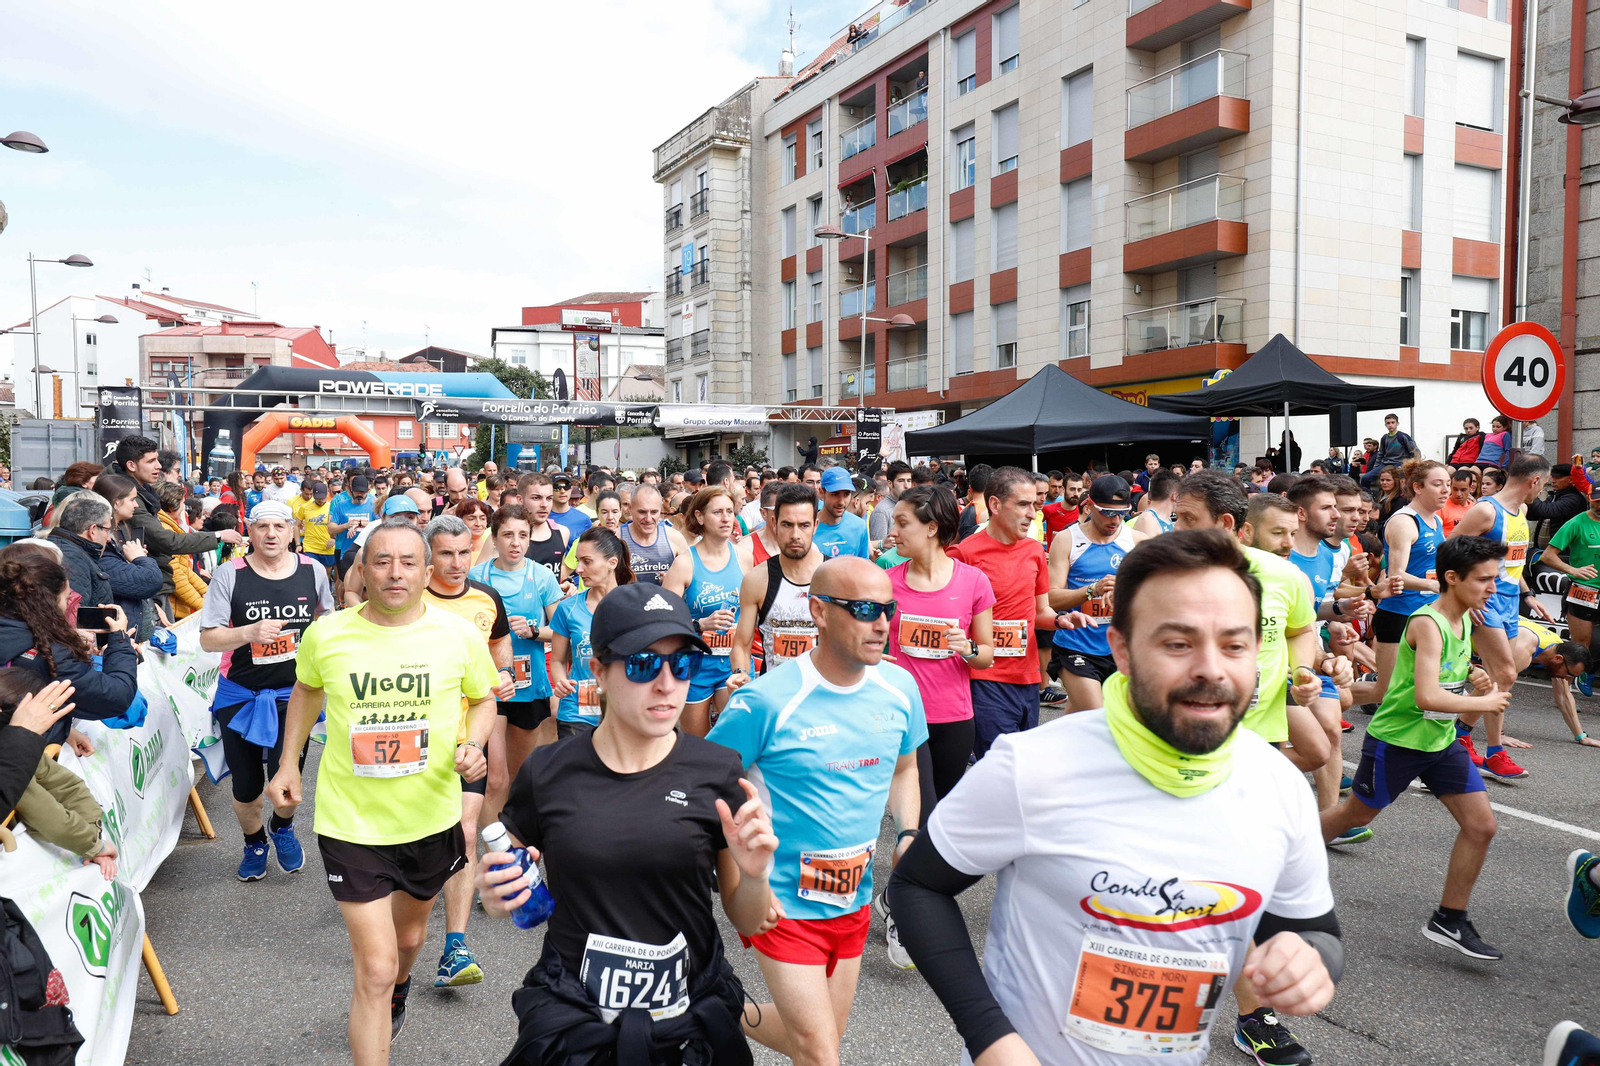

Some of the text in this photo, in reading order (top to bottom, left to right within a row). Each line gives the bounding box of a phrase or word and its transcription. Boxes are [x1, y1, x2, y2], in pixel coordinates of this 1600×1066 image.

[684, 251, 692, 268] 19
[1503, 357, 1550, 388] 40
[319, 380, 443, 397] POWERADE
[482, 402, 598, 416] Concello do Porriño
[290, 417, 337, 429] GADIS
[509, 414, 538, 422] Concello
[549, 415, 576, 423] Deporte
[627, 416, 653, 424] Porriño
[684, 418, 762, 427] Grupo Godoy Maceira
[1574, 590, 1594, 601] 1063
[711, 634, 732, 648] 1001
[910, 629, 941, 649] 408
[262, 640, 288, 657] 293
[782, 640, 808, 657] 797
[350, 700, 431, 710] CARREIRA POPULAR
[375, 740, 401, 764] 52
[814, 865, 863, 894] 1080
[592, 940, 604, 948] XIII
[605, 942, 636, 955] CARREIRA
[638, 948, 646, 956] DE
[1089, 942, 1105, 953] XIII
[1107, 946, 1148, 962] CARREIRA
[1150, 954, 1161, 964] DE
[1163, 956, 1170, 964] O
[1210, 960, 1218, 969] 10
[1220, 961, 1225, 970] K
[626, 959, 655, 971] MARIA
[1113, 963, 1188, 984] SINGER MORN
[599, 967, 672, 1009] 1624
[1104, 977, 1185, 1031] 375
